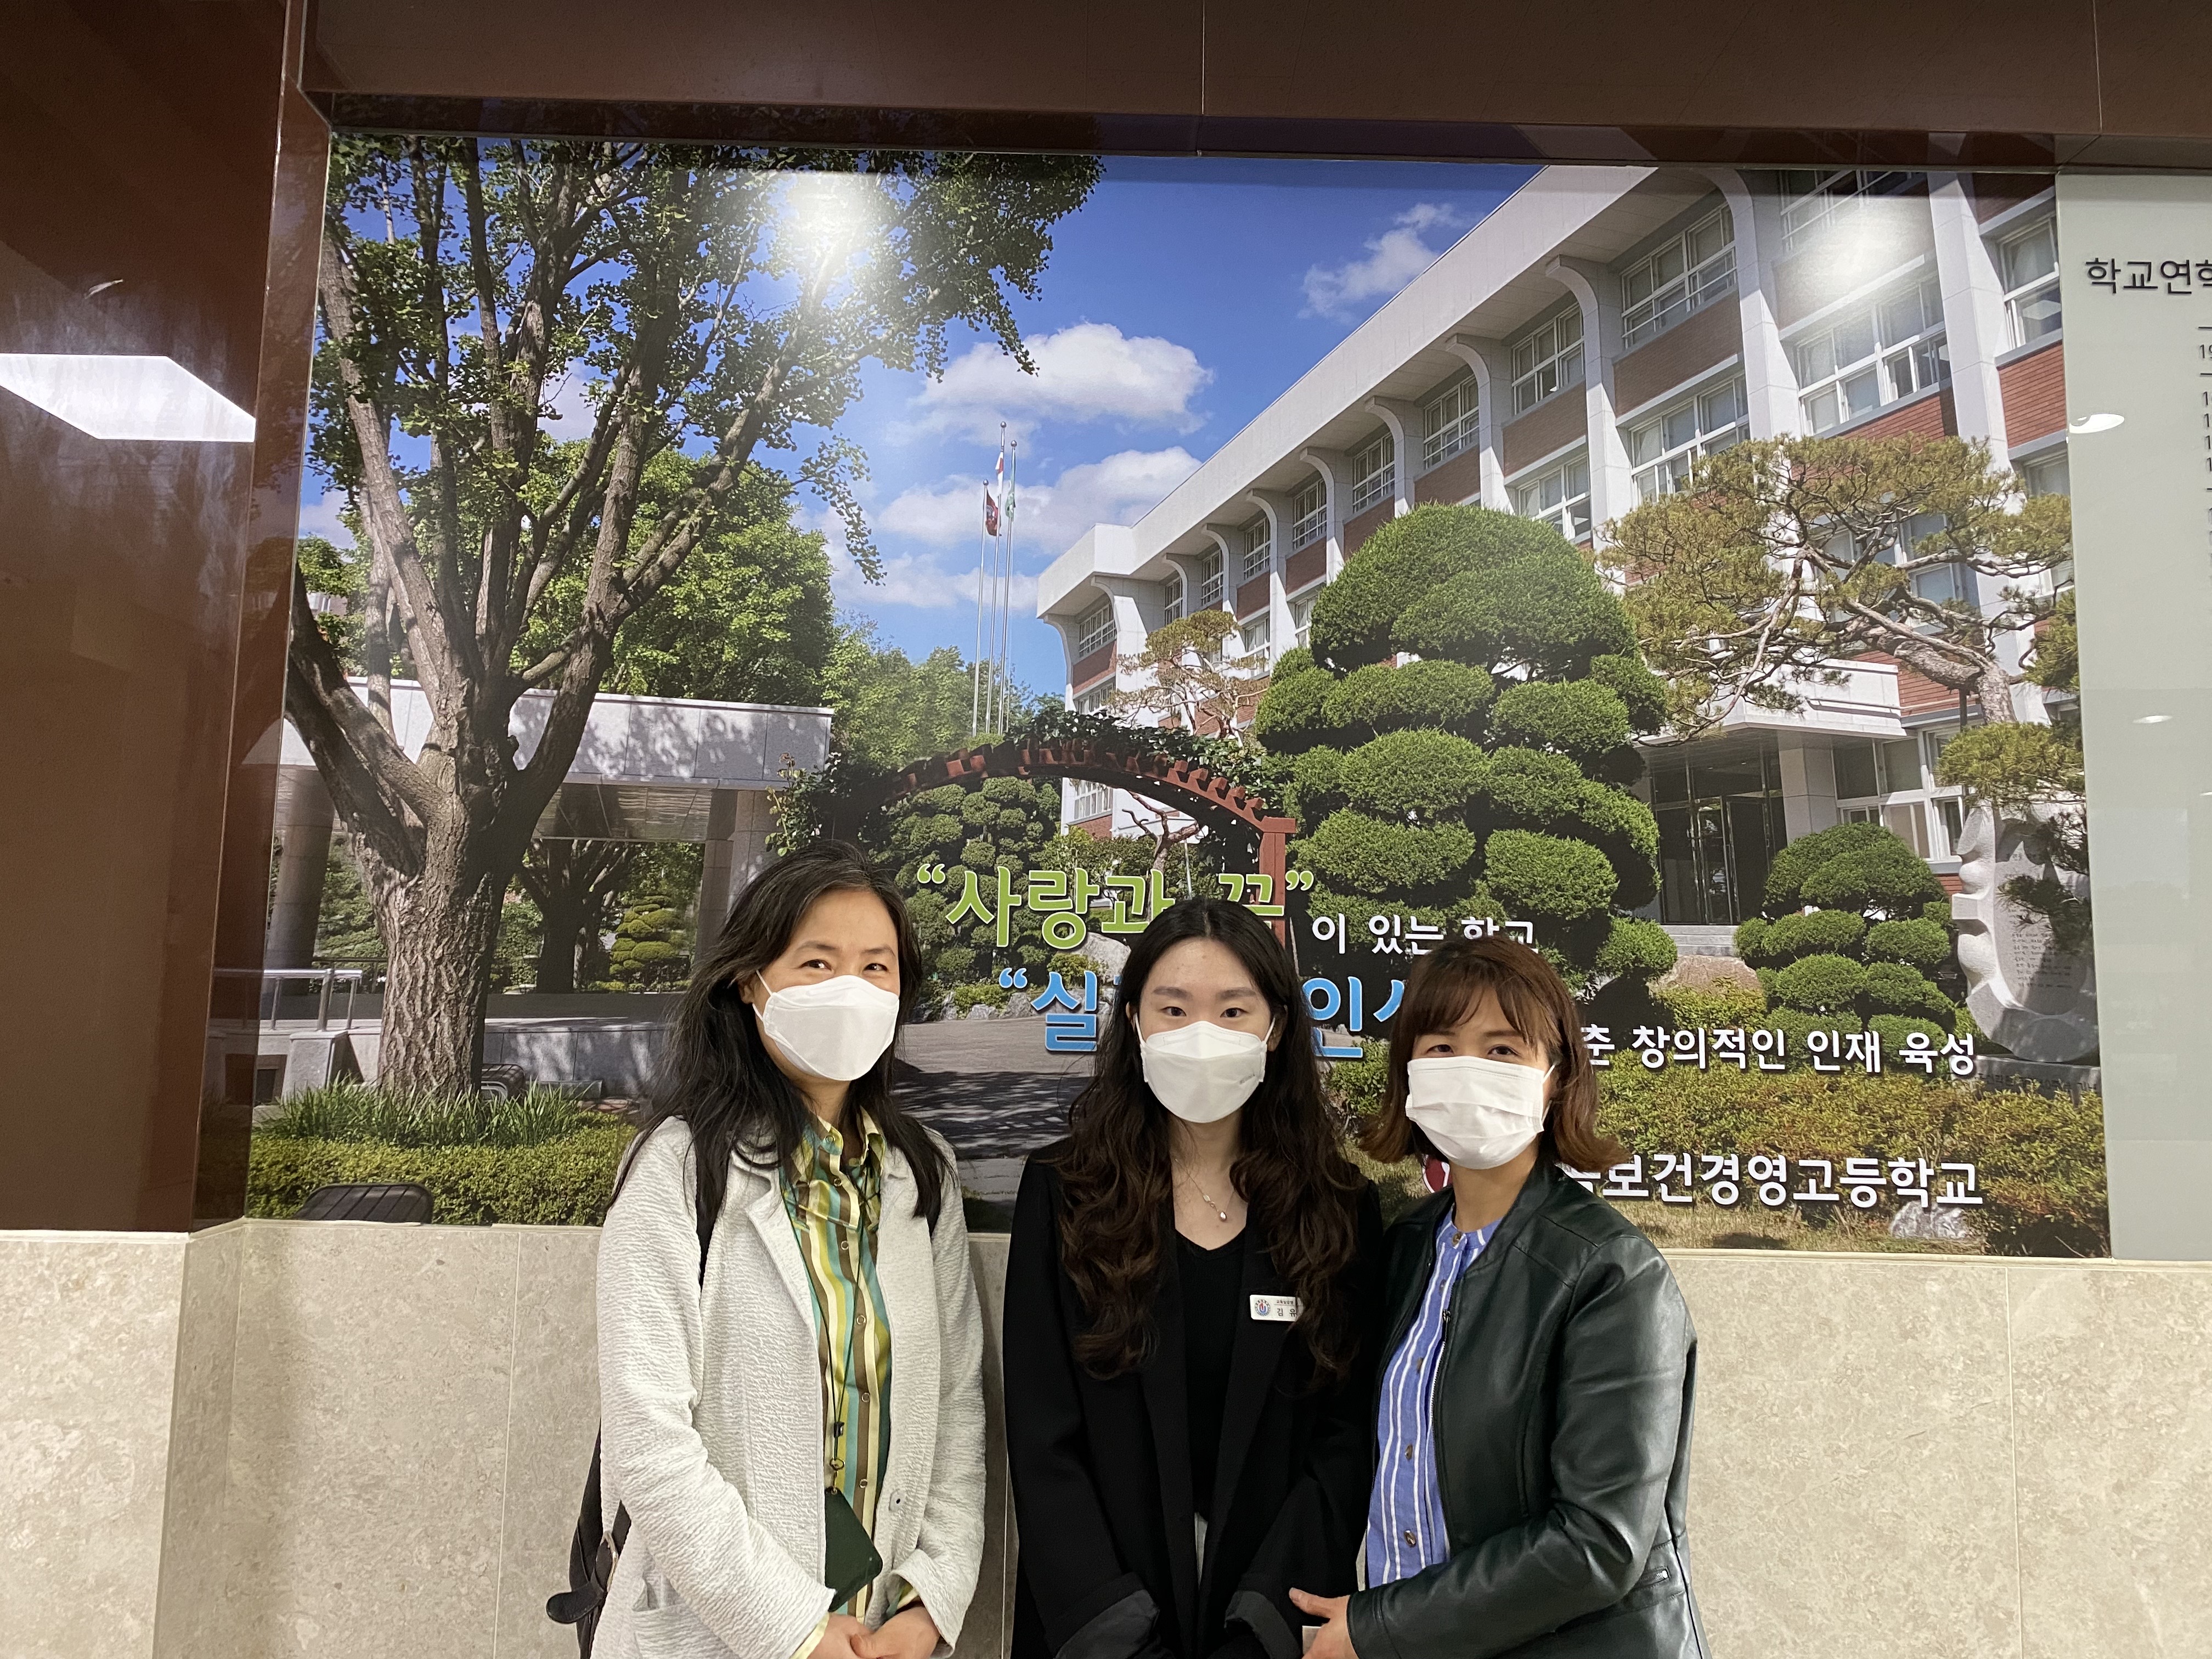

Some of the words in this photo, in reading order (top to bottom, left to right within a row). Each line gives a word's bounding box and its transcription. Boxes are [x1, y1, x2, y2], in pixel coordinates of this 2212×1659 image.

[917, 863, 1176, 949] “사랑과
[1368, 914, 1444, 955] 있는
[998, 967, 1122, 1052] “실
[1581, 1024, 1615, 1066] 춘
[1632, 1026, 1785, 1071] 창의적인
[1807, 1030, 1881, 1074] 인재
[1899, 1031, 1975, 1076] 육성
